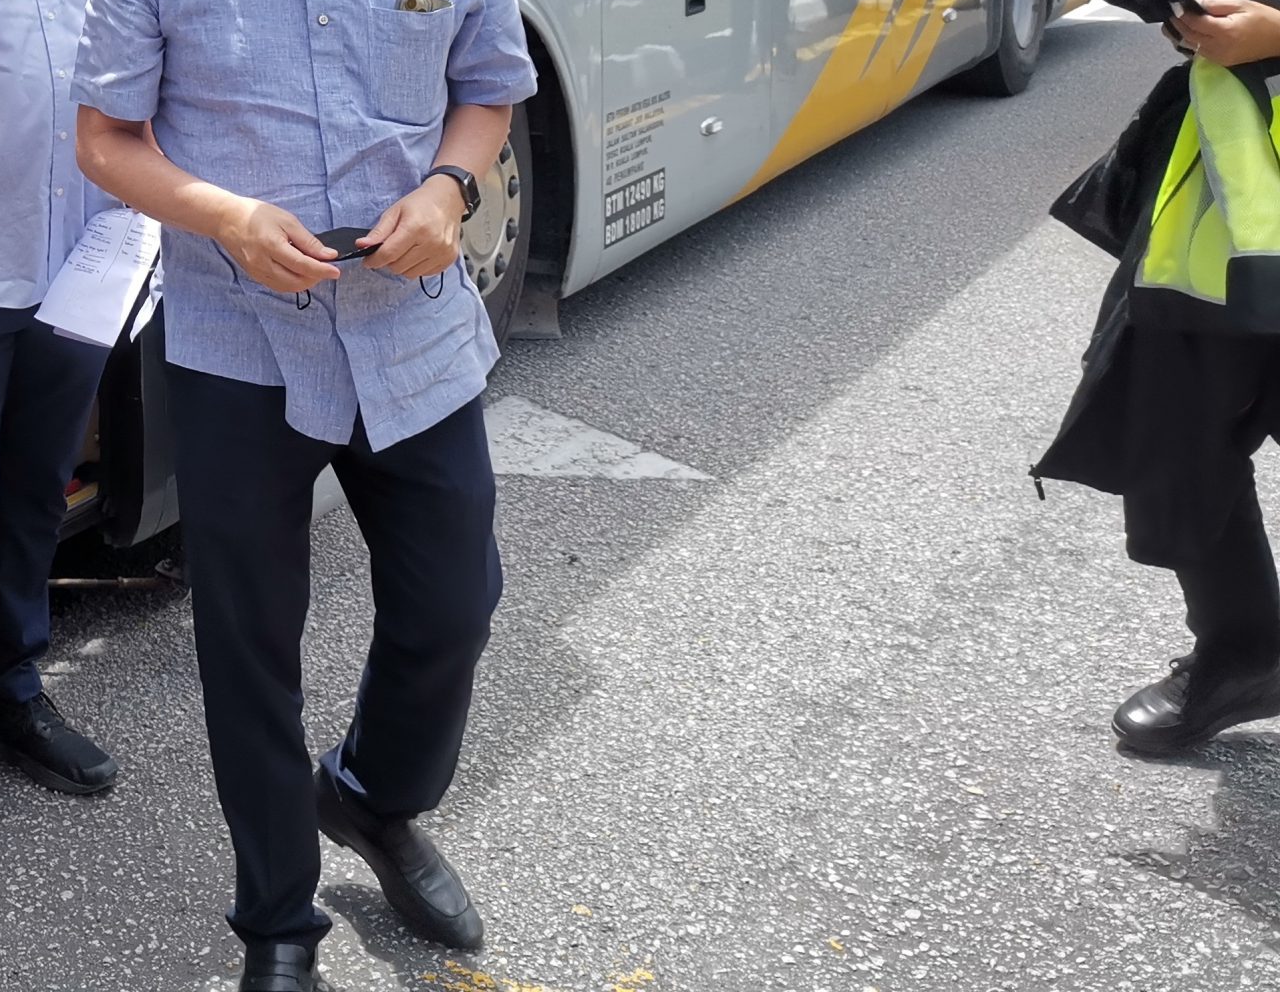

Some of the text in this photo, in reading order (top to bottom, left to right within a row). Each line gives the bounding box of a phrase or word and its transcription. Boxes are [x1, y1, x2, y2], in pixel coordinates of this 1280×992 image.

[606, 171, 665, 217] BTM 12490 KG
[605, 198, 665, 245] BDM 18000 KG
